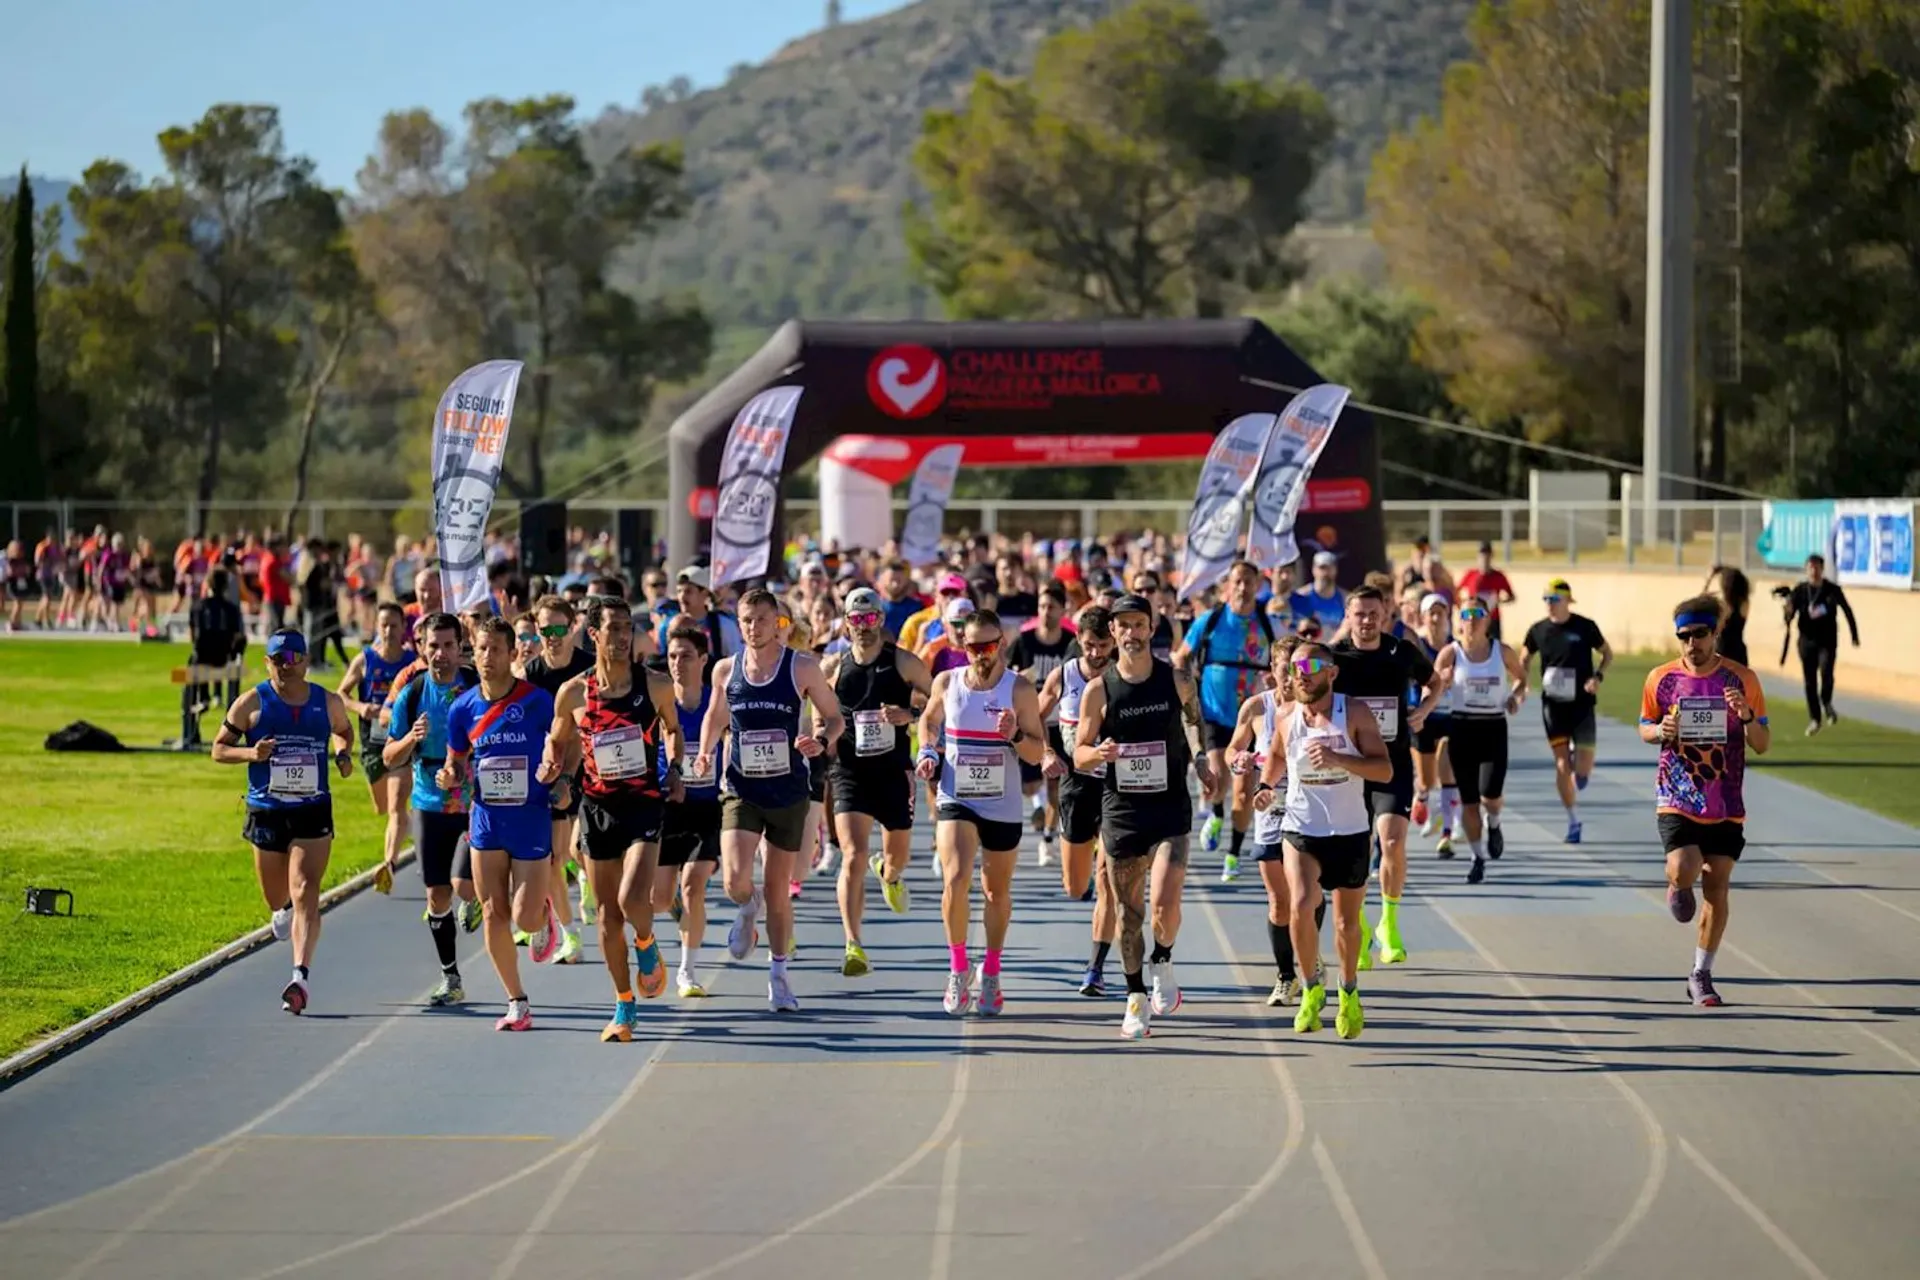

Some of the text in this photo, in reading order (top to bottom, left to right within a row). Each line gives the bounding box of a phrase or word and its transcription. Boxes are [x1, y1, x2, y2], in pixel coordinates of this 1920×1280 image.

[953, 350, 1103, 373] CHALLENGE
[443, 410, 508, 434] FOLLOW
[748, 701, 775, 710] EATON
[1692, 711, 1712, 724] 569
[862, 724, 881, 737] 265
[490, 732, 502, 745] DE
[503, 732, 527, 743] NOJA
[615, 745, 623, 757] 2
[753, 744, 774, 757] 514
[1130, 758, 1152, 771] 300
[285, 767, 304, 779] 192
[492, 772, 513, 785] 338
[969, 767, 990, 780] 322
